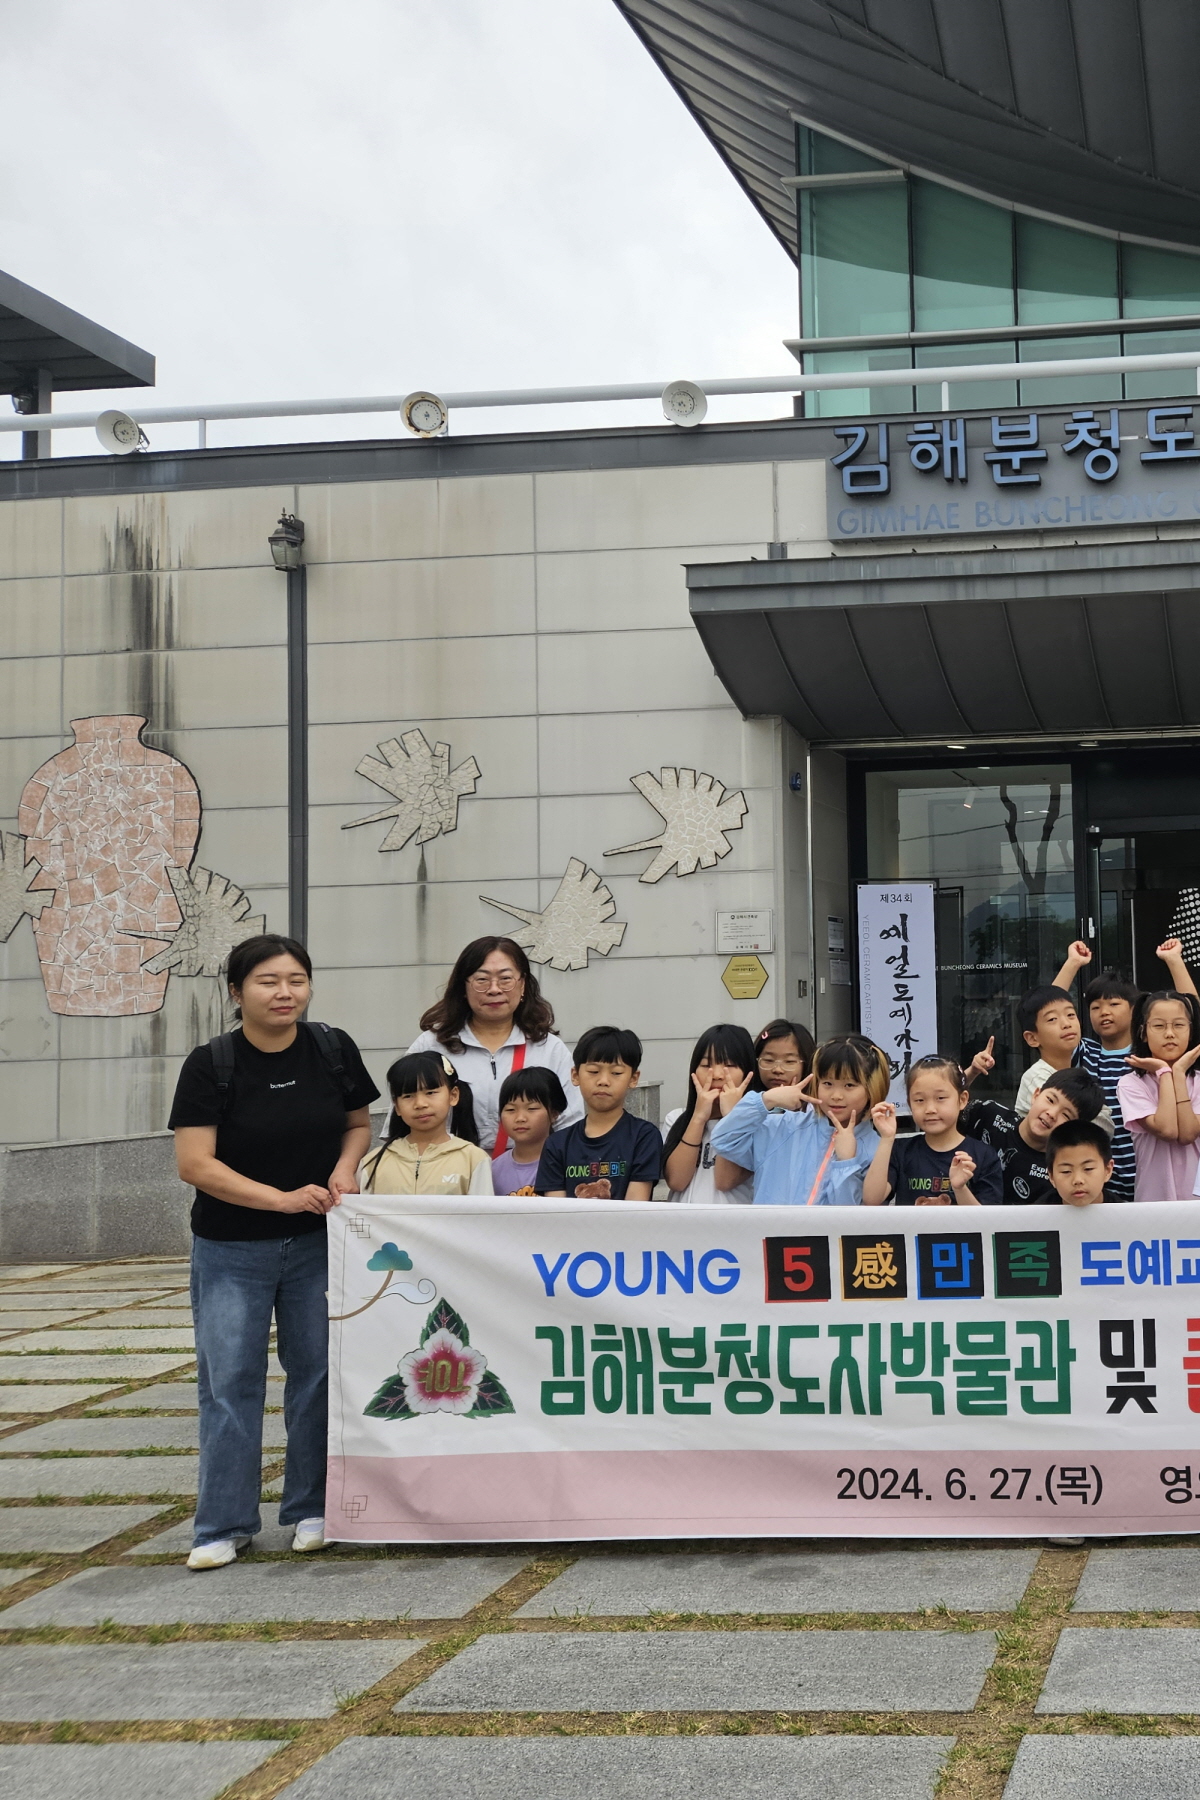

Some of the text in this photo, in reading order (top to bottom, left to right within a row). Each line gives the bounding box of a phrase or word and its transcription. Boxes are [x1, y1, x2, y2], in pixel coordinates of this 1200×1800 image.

[837, 502, 960, 535] GIMHAE
[975, 490, 1179, 529] BUNCHEONG
[880, 893, 912, 903] 제34회
[863, 947, 871, 990] CERAMIC
[864, 992, 872, 1024] ARTIST
[566, 1165, 590, 1178] YOUNG
[908, 1177, 932, 1190] YOUNG
[532, 1248, 741, 1298] YOUNG
[535, 1319, 1076, 1415] 김해분청도자박물관
[1099, 1318, 1158, 1414] 및
[836, 1467, 932, 1501] 2024.
[945, 1467, 976, 1501] 6.
[989, 1464, 1103, 1505] 27.(목)
